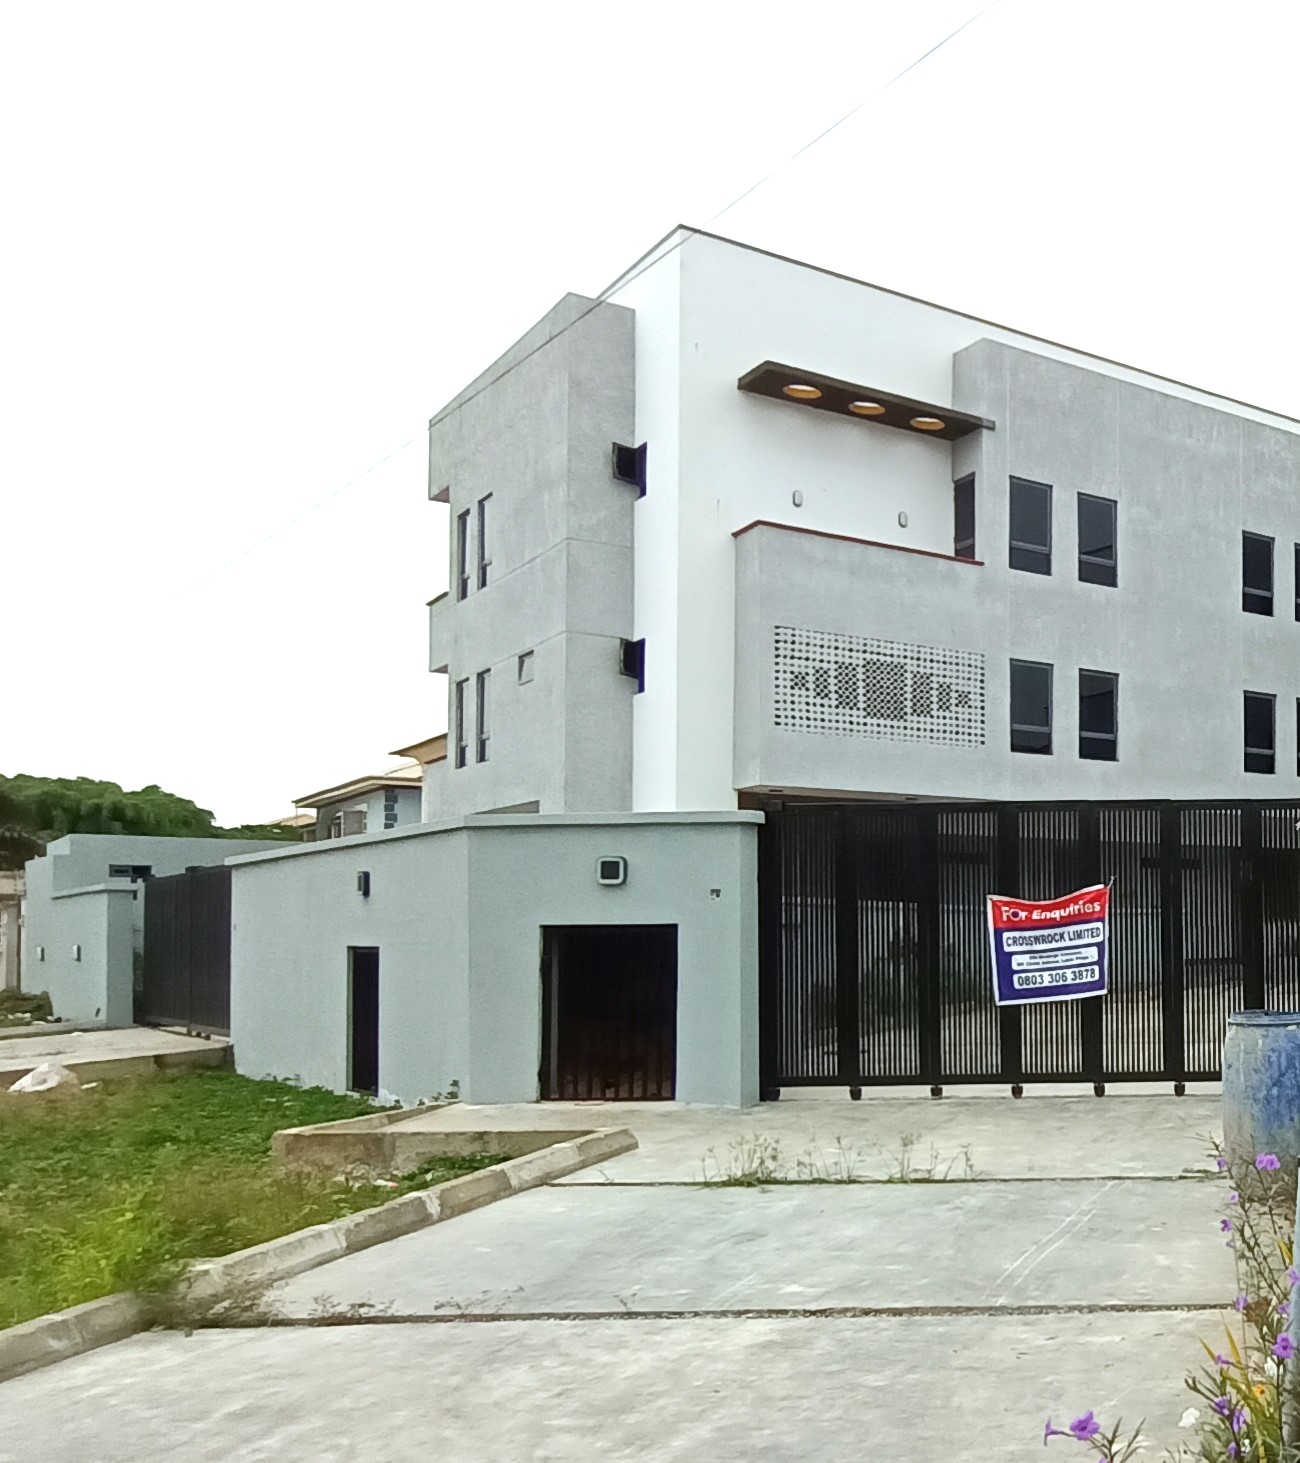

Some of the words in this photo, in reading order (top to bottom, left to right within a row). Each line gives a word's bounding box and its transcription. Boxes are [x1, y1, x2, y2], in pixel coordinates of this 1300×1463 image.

[1031, 901, 1101, 921] Enquiries
[1005, 931, 1066, 947] CROSSWROCK
[1067, 926, 1101, 942] LIMITED
[1017, 974, 1044, 986] 0803
[1047, 971, 1068, 984] 306
[1070, 968, 1096, 981] 3878
